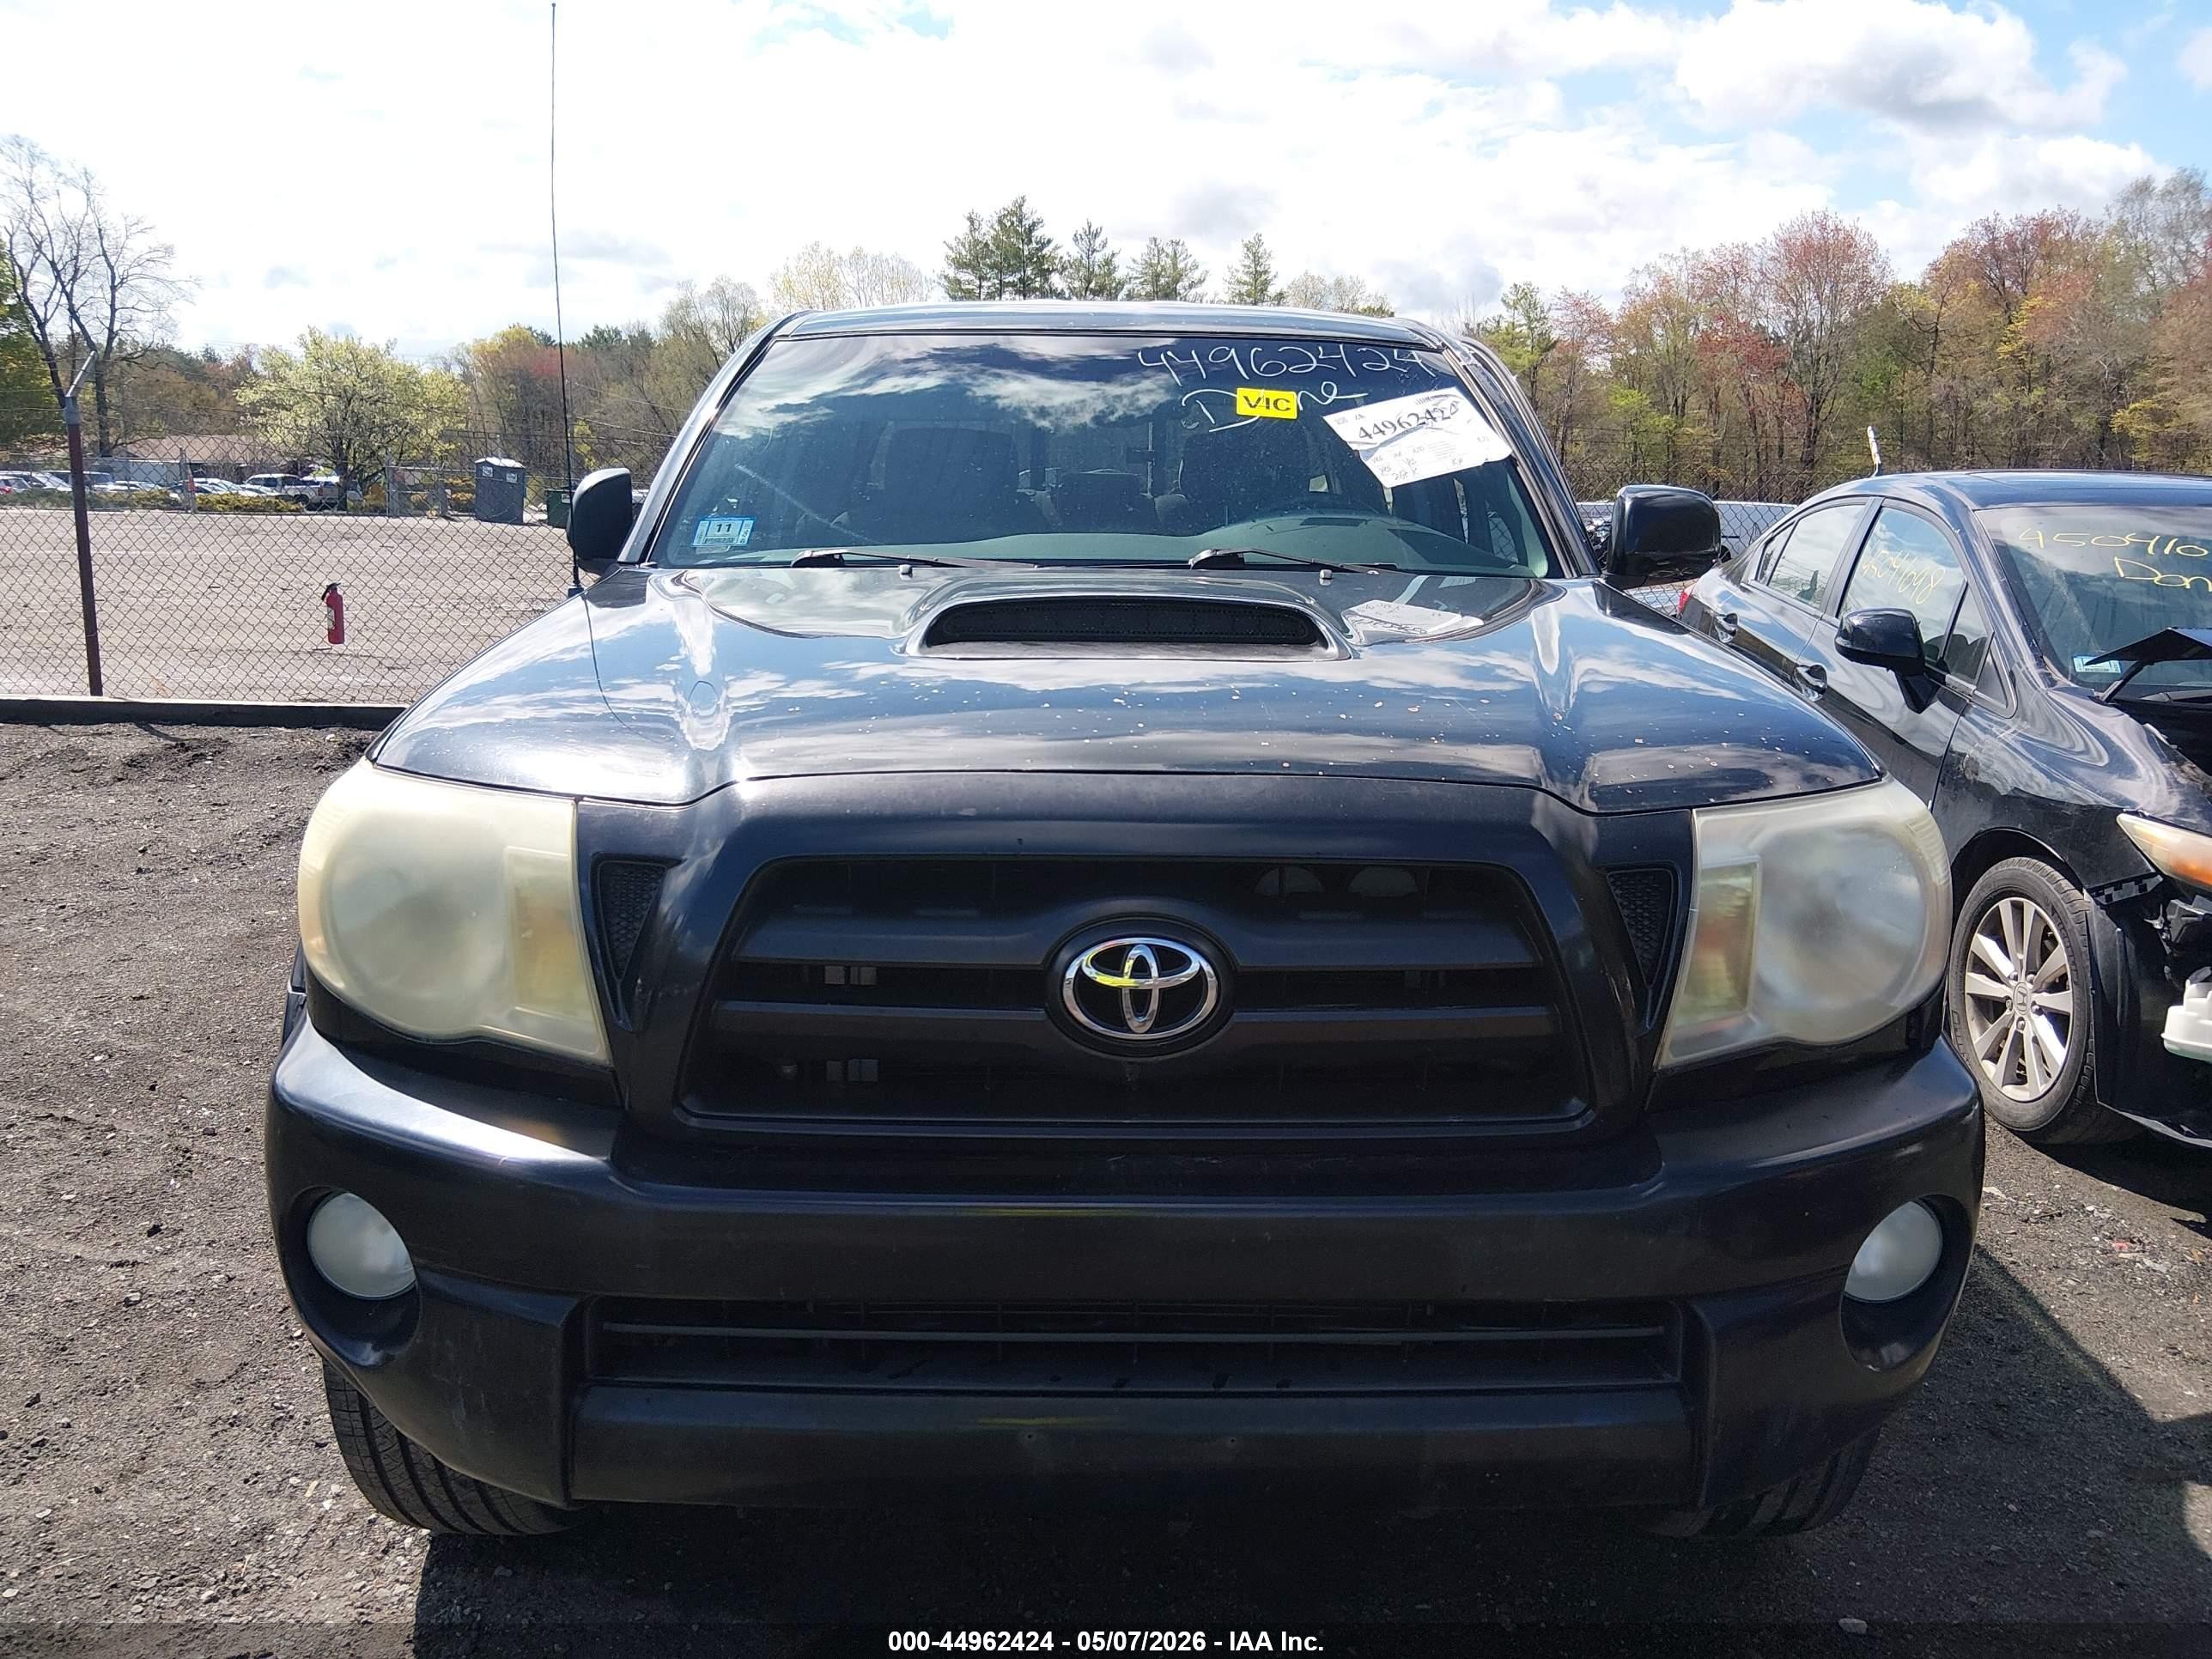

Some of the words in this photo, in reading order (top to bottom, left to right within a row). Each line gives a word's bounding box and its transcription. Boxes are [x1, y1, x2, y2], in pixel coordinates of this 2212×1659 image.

[1138, 344, 1437, 386] 44962424
[1243, 394, 1291, 413] VIC
[716, 522, 732, 533] 11
